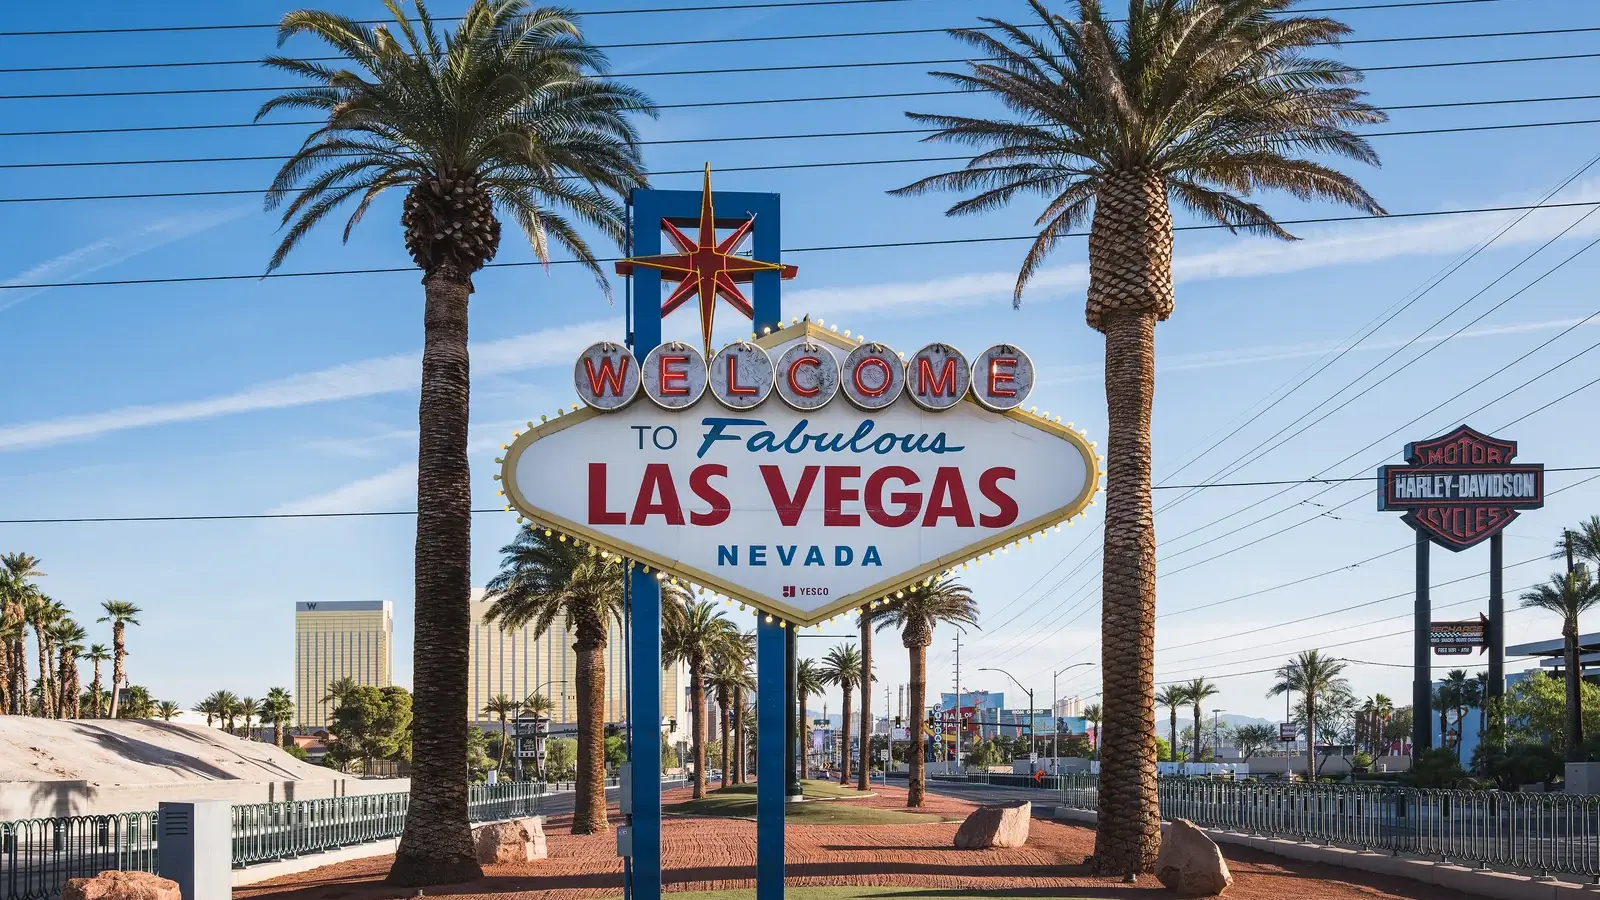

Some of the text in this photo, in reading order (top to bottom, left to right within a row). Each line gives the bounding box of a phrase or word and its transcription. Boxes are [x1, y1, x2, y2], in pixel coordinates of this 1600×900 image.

[583, 354, 1017, 398] WELCOME
[630, 417, 965, 459] TO Fabulous
[1428, 437, 1502, 464] MOTOR
[588, 462, 1019, 528] LAS VEGAS
[1395, 472, 1535, 498] HARLEY-DAVIDSON
[1427, 507, 1501, 538] CYCLES
[717, 545, 883, 567] NEVADA
[800, 587, 829, 596] YESCO
[306, 602, 317, 610] W
